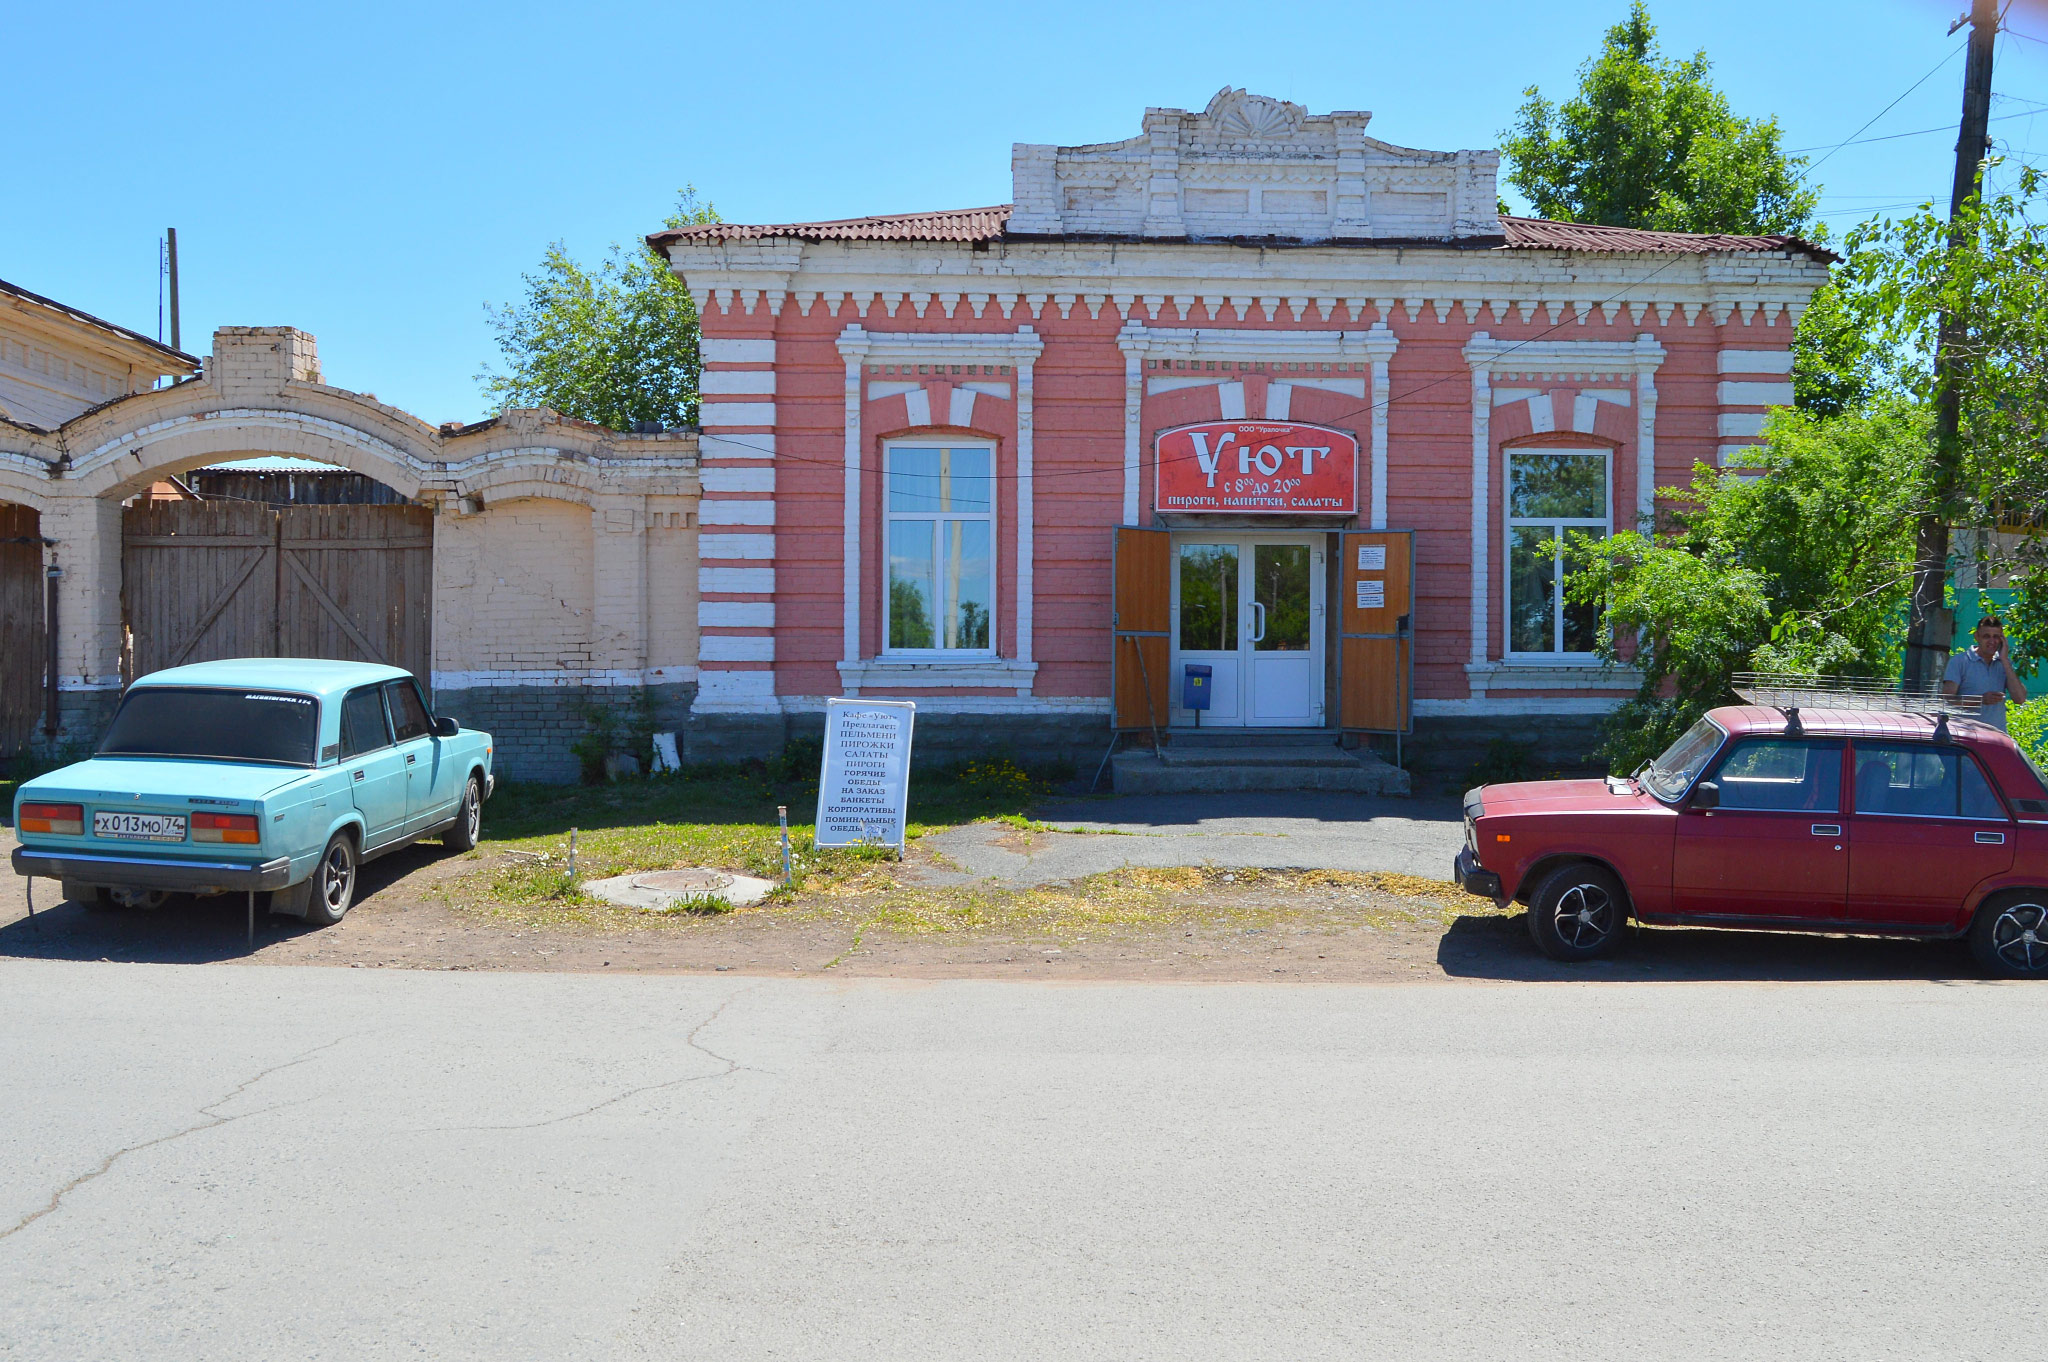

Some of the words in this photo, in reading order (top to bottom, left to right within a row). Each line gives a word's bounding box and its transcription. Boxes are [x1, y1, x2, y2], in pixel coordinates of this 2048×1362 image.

[1256, 426, 1293, 434] "Уралочка"
[1188, 432, 1331, 488] Уют
[1224, 482, 1231, 493] с
[1252, 482, 1268, 496] до
[1167, 496, 1219, 508] пироги,
[1223, 496, 1287, 508] напитки,
[1291, 497, 1343, 507] салаты
[842, 711, 867, 720] Кафе
[840, 730, 896, 740] ПЕЛЬМЕНИ
[841, 740, 894, 749] ПИРОЖКИ
[844, 750, 888, 758] САЛАТЫ
[846, 760, 886, 769] ПИРОГИ
[844, 770, 886, 778] ГОРЯЧИЕ
[828, 806, 896, 814] КОРПОРАТИВЫ
[825, 816, 897, 824] ПОМИНАЛЬНЫЕ
[830, 825, 863, 833] ОБЕДЫ
